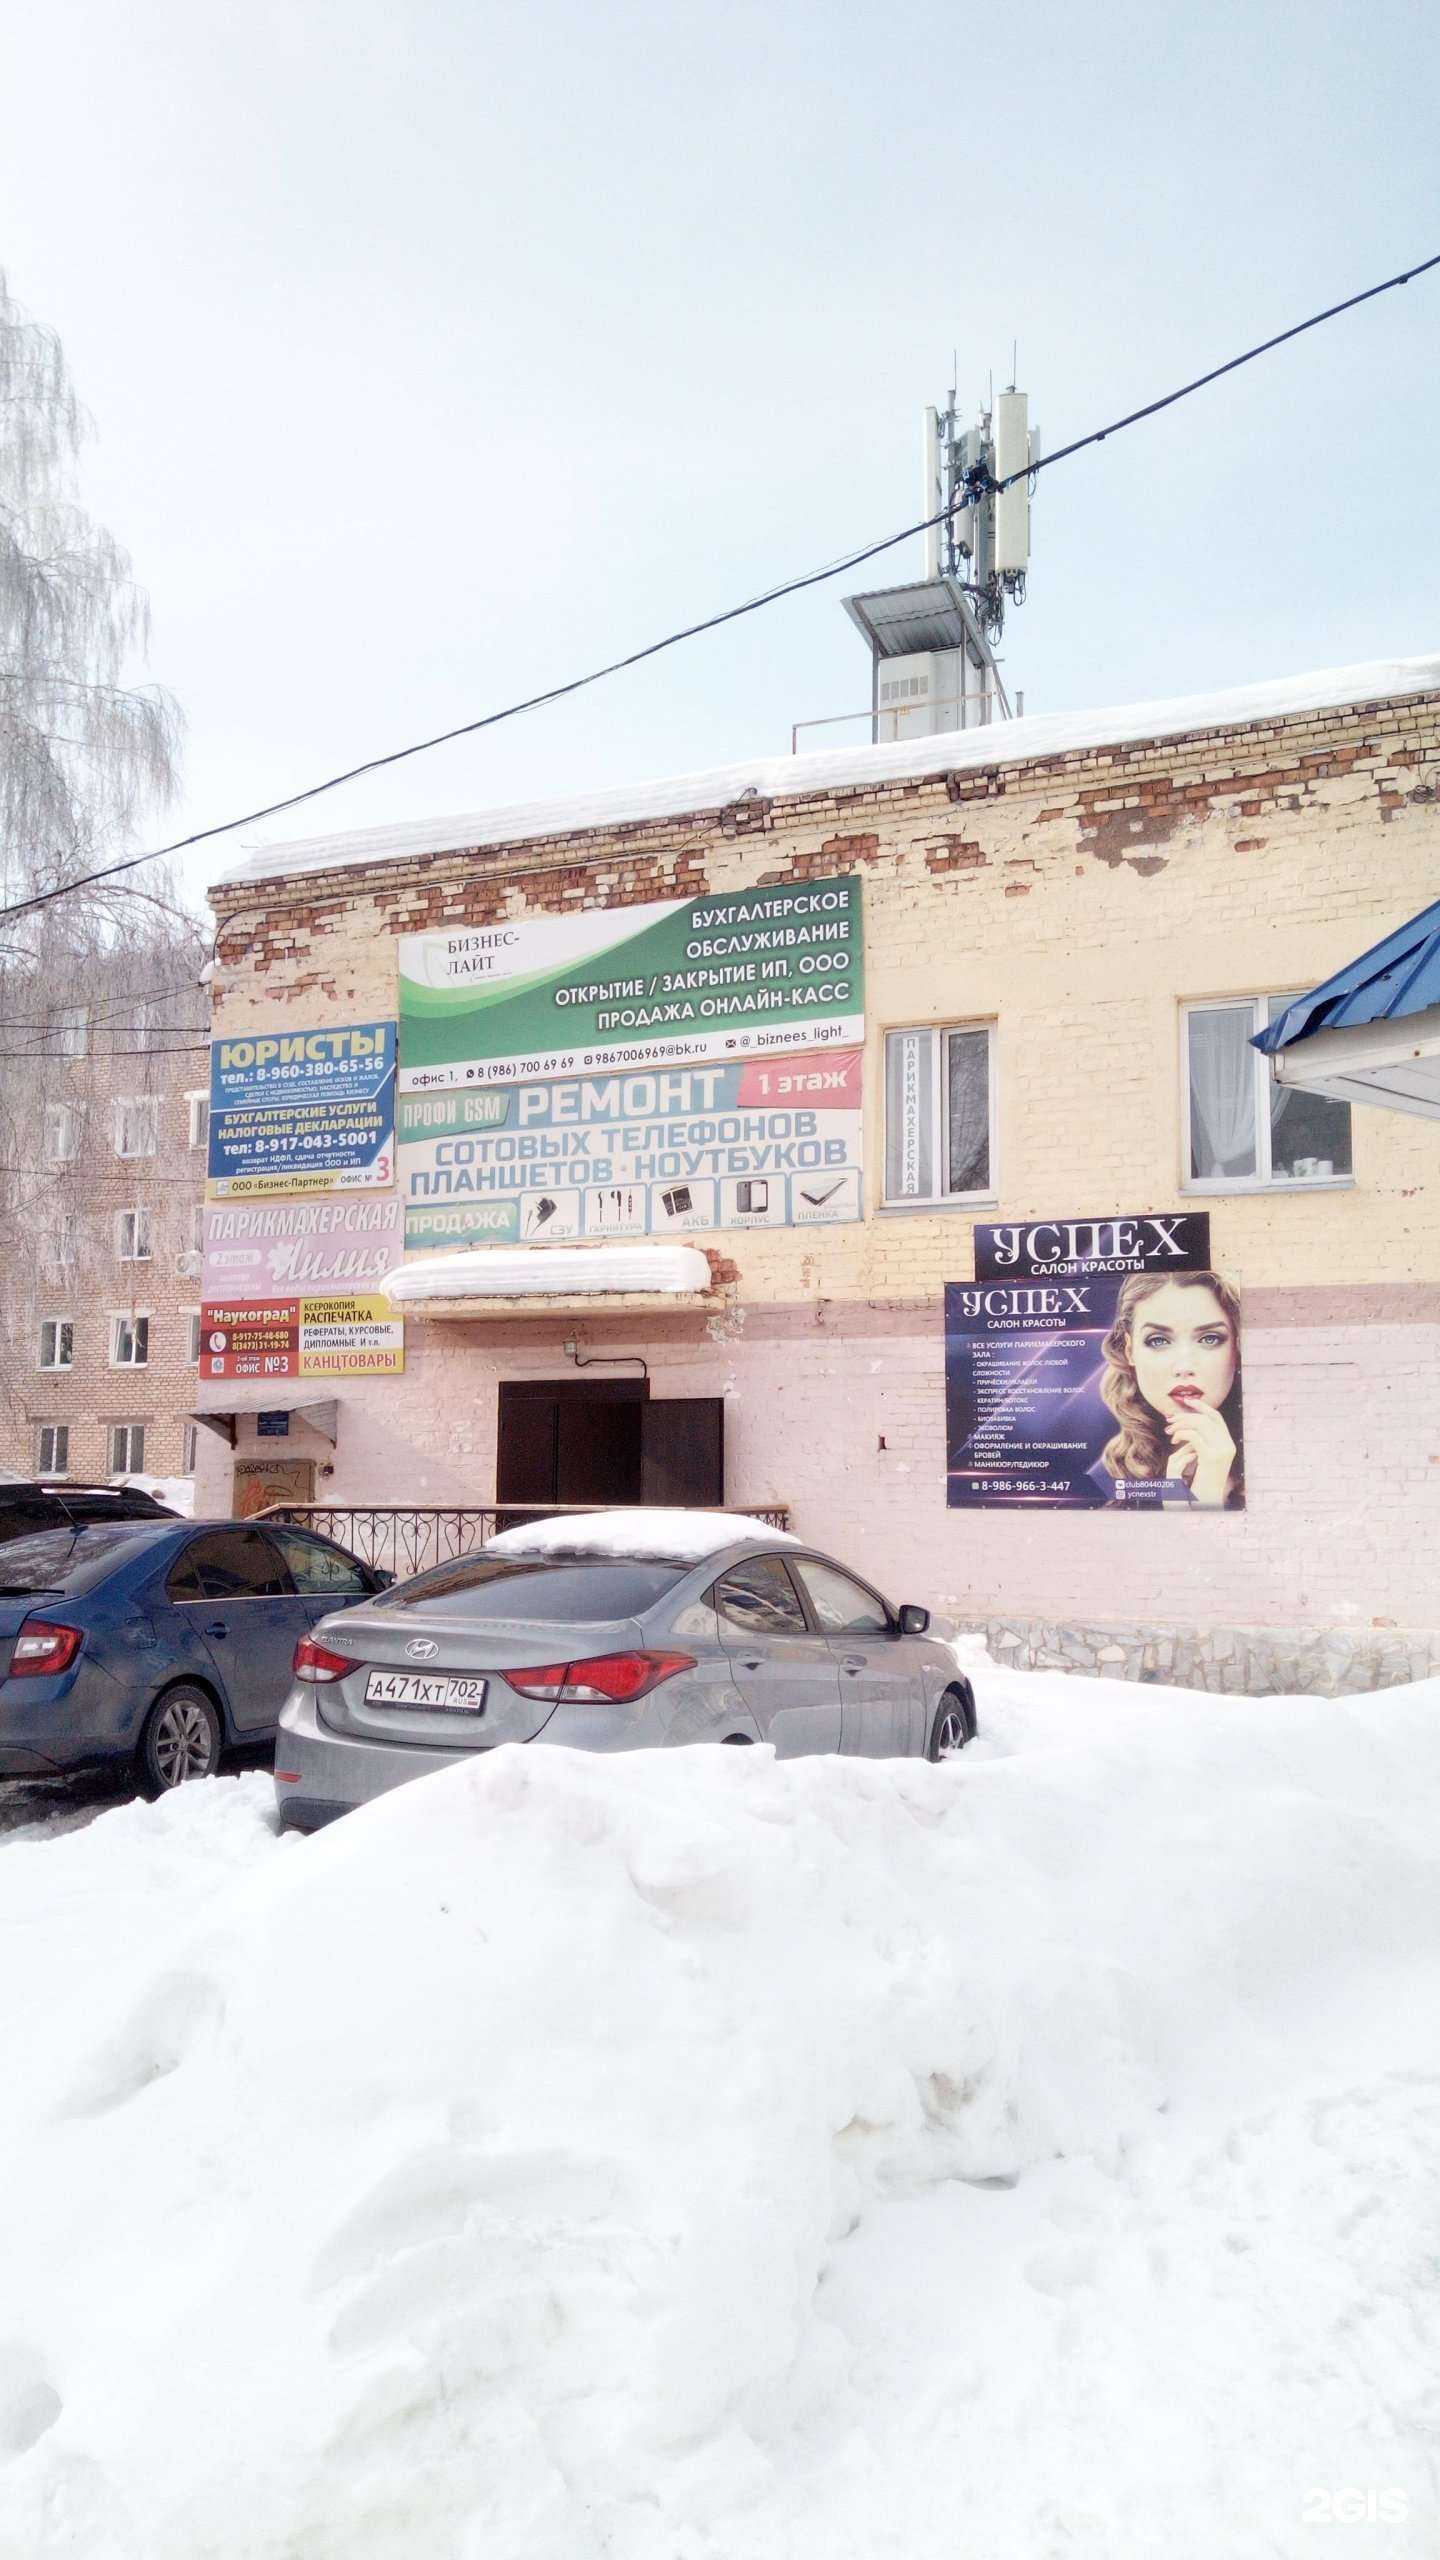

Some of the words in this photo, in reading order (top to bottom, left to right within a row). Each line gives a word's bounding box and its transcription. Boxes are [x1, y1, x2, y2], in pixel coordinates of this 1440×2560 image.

[692, 891, 849, 929] БУХГАЛТЕРСКОЕ
[448, 931, 520, 954] БИЗНЕС-
[686, 921, 849, 959] ОБСЛУЖИВАНИЕ
[447, 954, 495, 975] ЛАЙТ
[555, 979, 644, 1006] ОТКРЫТИЕ
[662, 964, 756, 992] ЗАКРЫТИЕ
[762, 960, 792, 978] ИП,
[799, 952, 849, 974] ООО
[598, 1002, 695, 1030] ПРОДАЖА
[701, 982, 849, 1016] ОНЛАЙН-КАСС
[220, 1028, 385, 1069] ЮРИСТЫ
[220, 1071, 253, 1085] тел.:
[256, 1057, 384, 1080] 8-960-380-65-56
[412, 1074, 444, 1086] офис
[449, 1071, 458, 1081] 1,
[478, 1067, 484, 1077] 8
[488, 1064, 516, 1079] (986)
[520, 1062, 540, 1073] 700
[544, 1059, 557, 1070] 69
[561, 1056, 574, 1068] 69
[595, 1042, 707, 1065] 9867006969@bk.ru
[759, 1074, 770, 1094] 1
[777, 1070, 848, 1093] этаж
[519, 1068, 725, 1126] РЕМОНТ
[224, 1107, 328, 1125] БУХГАЛТЕРСКИЕ
[330, 1102, 377, 1117] УСЛУГИ
[404, 1103, 456, 1128] ПРОФИ
[464, 1097, 500, 1121] GSM
[906, 1038, 916, 1193] ПАРИКМАХЕРСКАЯ
[218, 1124, 293, 1139] НАЛОГОВЫЕ
[295, 1116, 383, 1135] ДЕКЛАРАЦИИ
[435, 1131, 591, 1166] СОТОВЫХ
[602, 1111, 817, 1152] ТЕЛЕФОНОВ
[224, 1144, 252, 1155] тел:
[255, 1131, 377, 1152] 8-917-043-5001
[232, 1181, 252, 1190] ООО
[341, 1174, 362, 1183] ОФИС
[376, 1157, 389, 1181] 3
[411, 1159, 613, 1195] ПЛАНШЕТОВ
[634, 1139, 847, 1179] НОУТБУКОВ
[208, 1202, 398, 1240] ПАРИКМАХЕРСКАЯ
[407, 1212, 510, 1234] ПРОДАЖА
[682, 1216, 709, 1227] АКБ
[989, 1218, 1188, 1264] УСПЕХ
[1031, 1263, 1078, 1275] САЛОН
[1082, 1260, 1145, 1273] КРАСОТЫ
[304, 1301, 355, 1310] КСЕРОКОПИЯ
[960, 1287, 1091, 1316] УСПЕХ
[208, 1307, 295, 1325] "Наукоград"
[304, 1310, 373, 1323] РАСПЕЧАТКА
[987, 1320, 1020, 1329] САЛОН
[1022, 1318, 1066, 1328] КРАСОТЫ
[304, 1327, 347, 1336] РЕФЕРАТЫ,
[349, 1325, 393, 1335] КУРСОВЫЕ,
[304, 1339, 356, 1350] ДИПЛОМНЫЕ
[236, 1363, 260, 1373] ОФИС
[304, 1354, 396, 1371] КАНЦТОВАРЫ
[982, 1482, 1070, 1490] 8-986-966-3-447
[450, 1680, 478, 1698] 702
